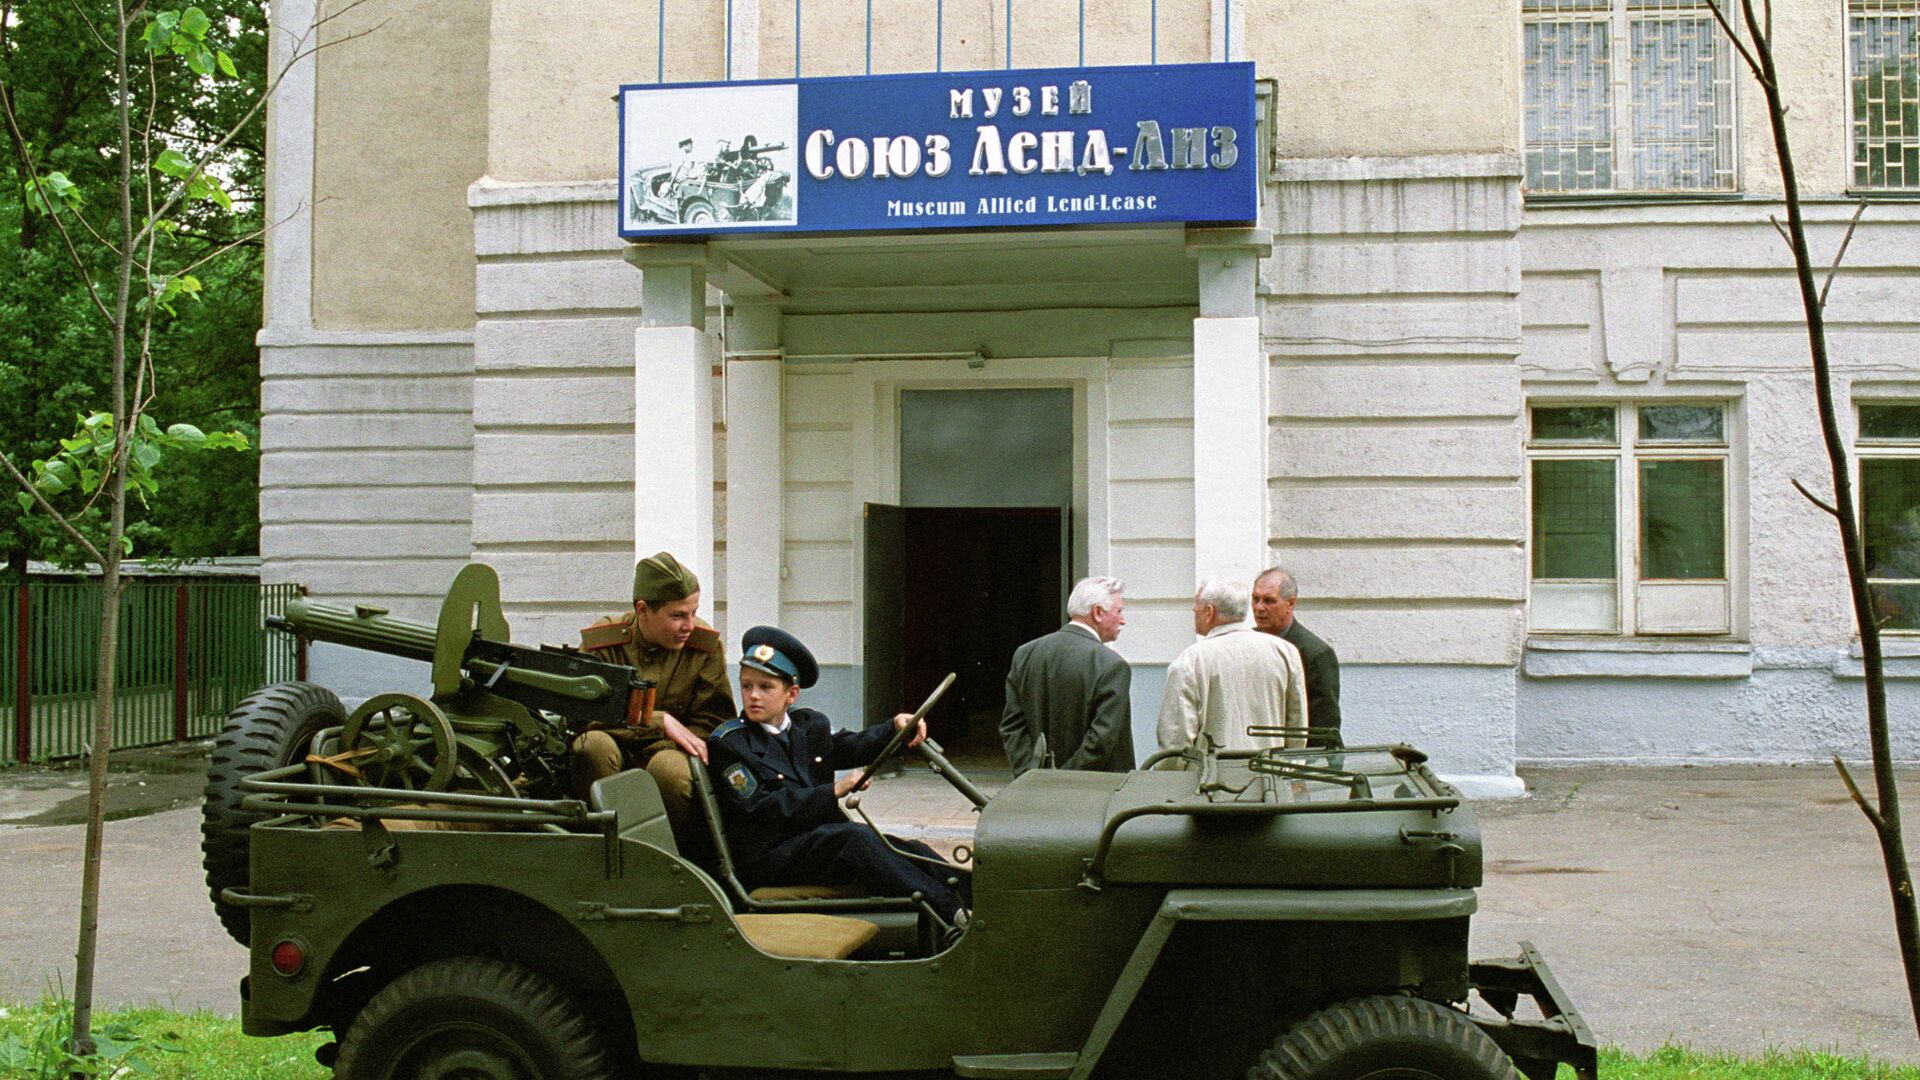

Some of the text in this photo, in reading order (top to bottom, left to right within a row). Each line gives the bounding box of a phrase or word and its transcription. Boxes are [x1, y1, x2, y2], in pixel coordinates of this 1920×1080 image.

[949, 79, 1092, 118] МУЗЕЙ
[805, 120, 1238, 180] Союз Ленд-Лиз
[887, 194, 1157, 217] Museum Allied Lend-Lease
